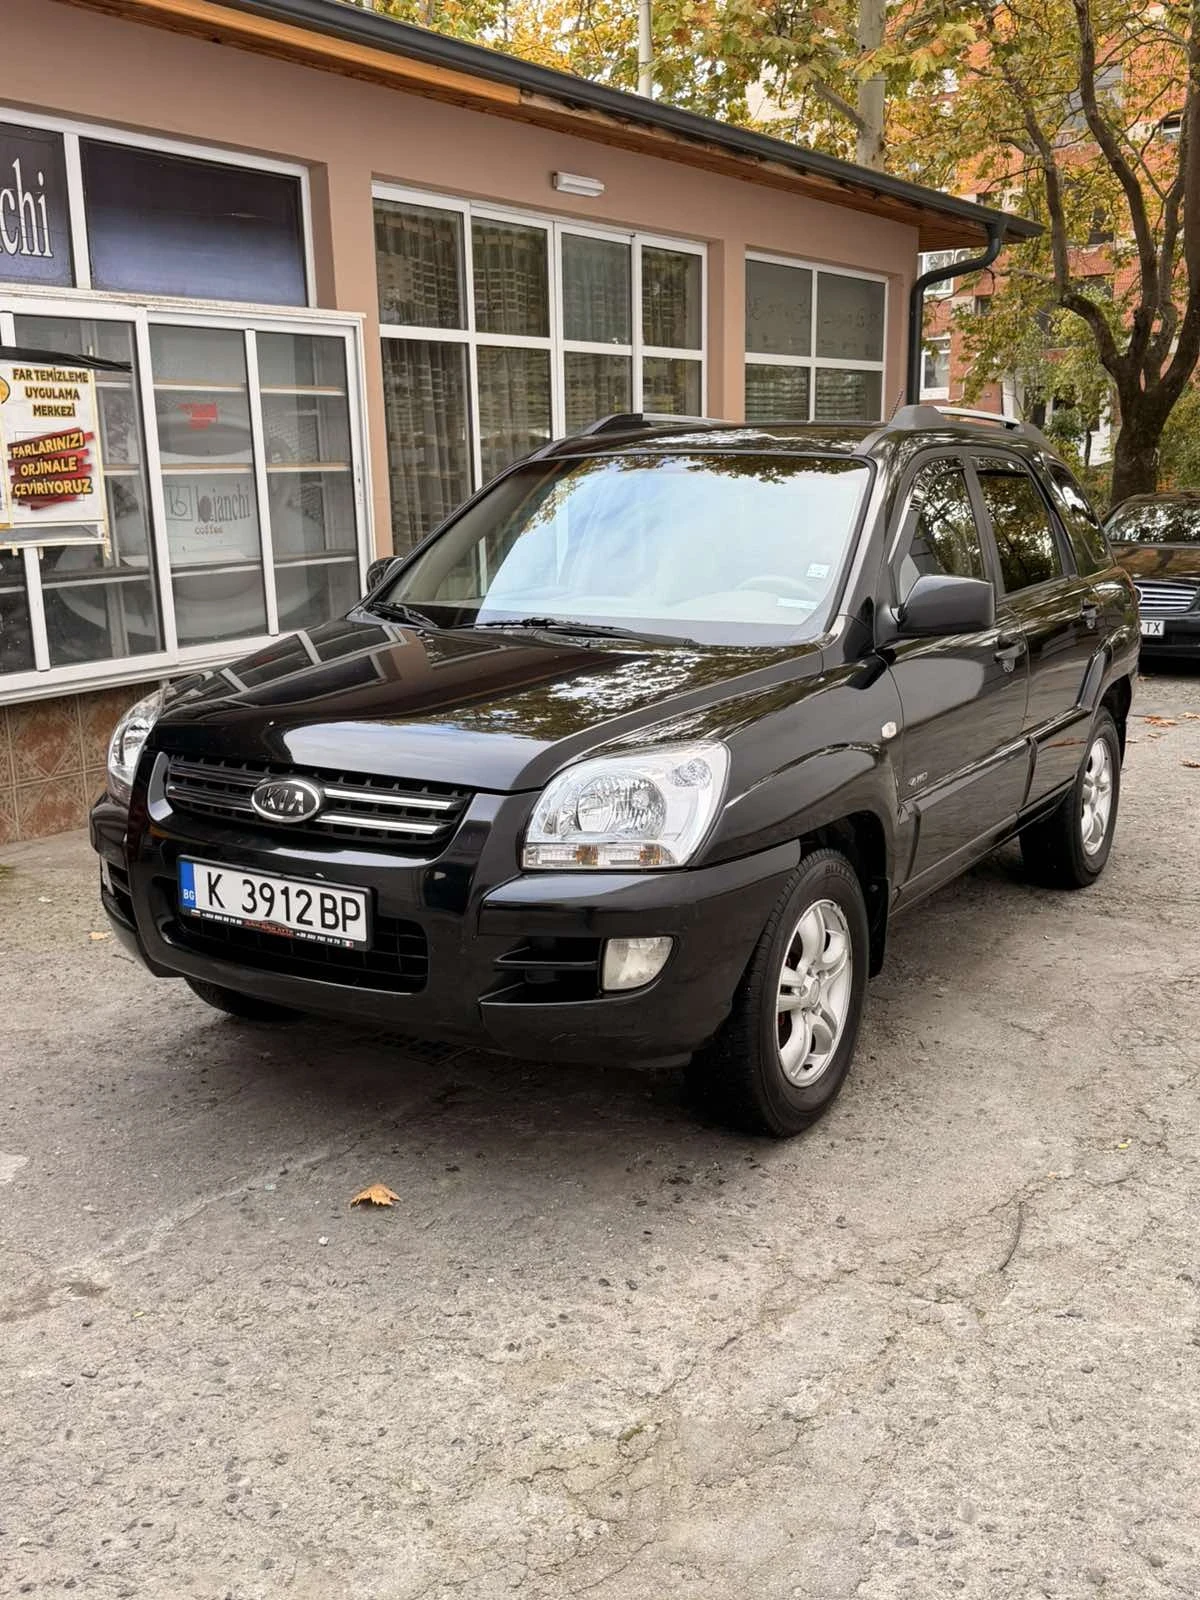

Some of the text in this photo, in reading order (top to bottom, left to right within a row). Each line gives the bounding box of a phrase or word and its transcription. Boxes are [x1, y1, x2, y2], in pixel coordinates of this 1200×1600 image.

[0, 157, 54, 258] chi
[12, 368, 89, 383] FAR TEMİZLEME
[25, 386, 81, 400] UYGULAMA
[33, 403, 77, 417] MERKEZİ
[12, 431, 84, 459] FARLARINIZI
[20, 455, 78, 476] ORJİNALE
[14, 478, 92, 497] ÇEVİRİYORUZ
[261, 785, 305, 814] KIA
[183, 888, 195, 901] BG
[207, 871, 225, 909] K
